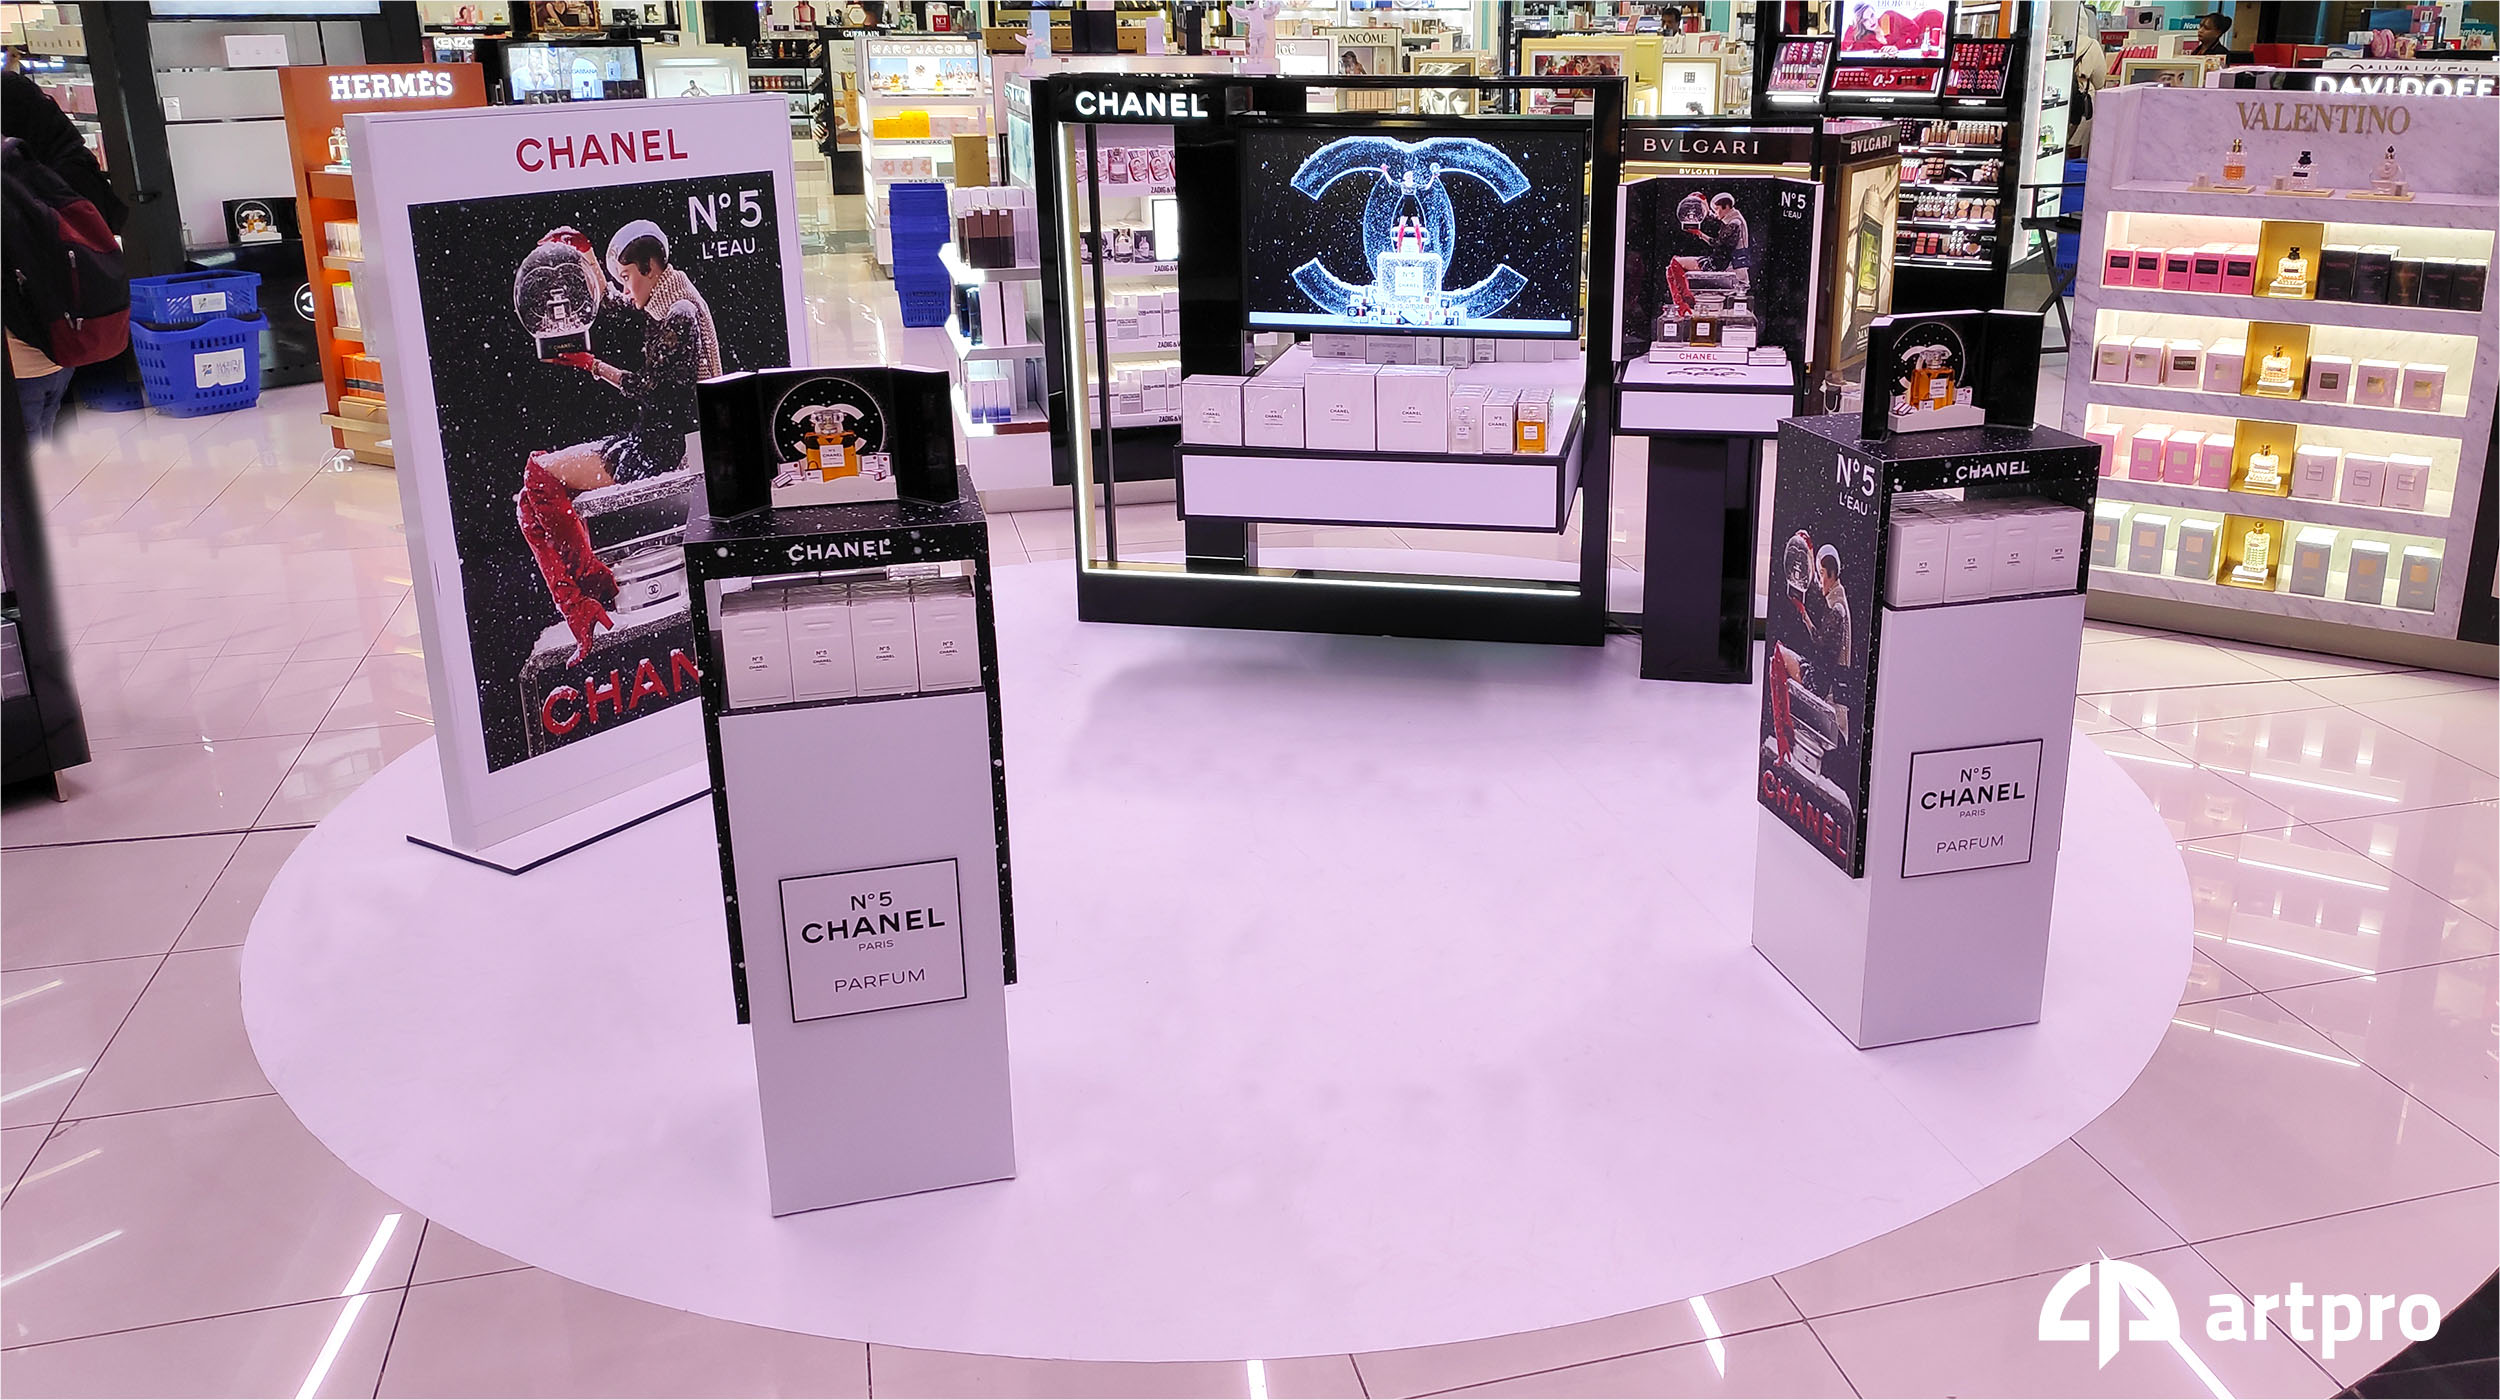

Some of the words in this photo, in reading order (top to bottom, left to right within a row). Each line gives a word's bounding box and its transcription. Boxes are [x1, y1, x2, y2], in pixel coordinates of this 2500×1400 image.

[843, 30, 880, 38] GUERLAIN
[871, 44, 913, 55] MARC
[916, 44, 975, 55] JACOBS
[328, 70, 453, 100] HERMÈS
[2314, 76, 2495, 97] DAVIDOFF
[1075, 90, 1209, 118] CHANEL
[2236, 102, 2411, 135] VALENTINO
[515, 128, 688, 172] CHANEL
[1643, 138, 1760, 155] BVLGARI
[1849, 135, 1893, 155] BVLGARI
[1783, 210, 1802, 219] L'EAU
[702, 236, 757, 260] L'EAU
[1679, 352, 1717, 361] CHANEL
[1955, 460, 2030, 481] CHANEL
[1838, 492, 1868, 516] L'EAU
[789, 540, 892, 562] CHANEL
[1920, 782, 2026, 810] CHANEL
[1761, 769, 1847, 859] CHANEL
[1959, 808, 1986, 819] PARIS
[1936, 834, 2004, 854] PARFUM
[801, 908, 946, 944] CHANEL
[858, 940, 894, 951] PARIS
[834, 968, 926, 993] PARFUM
